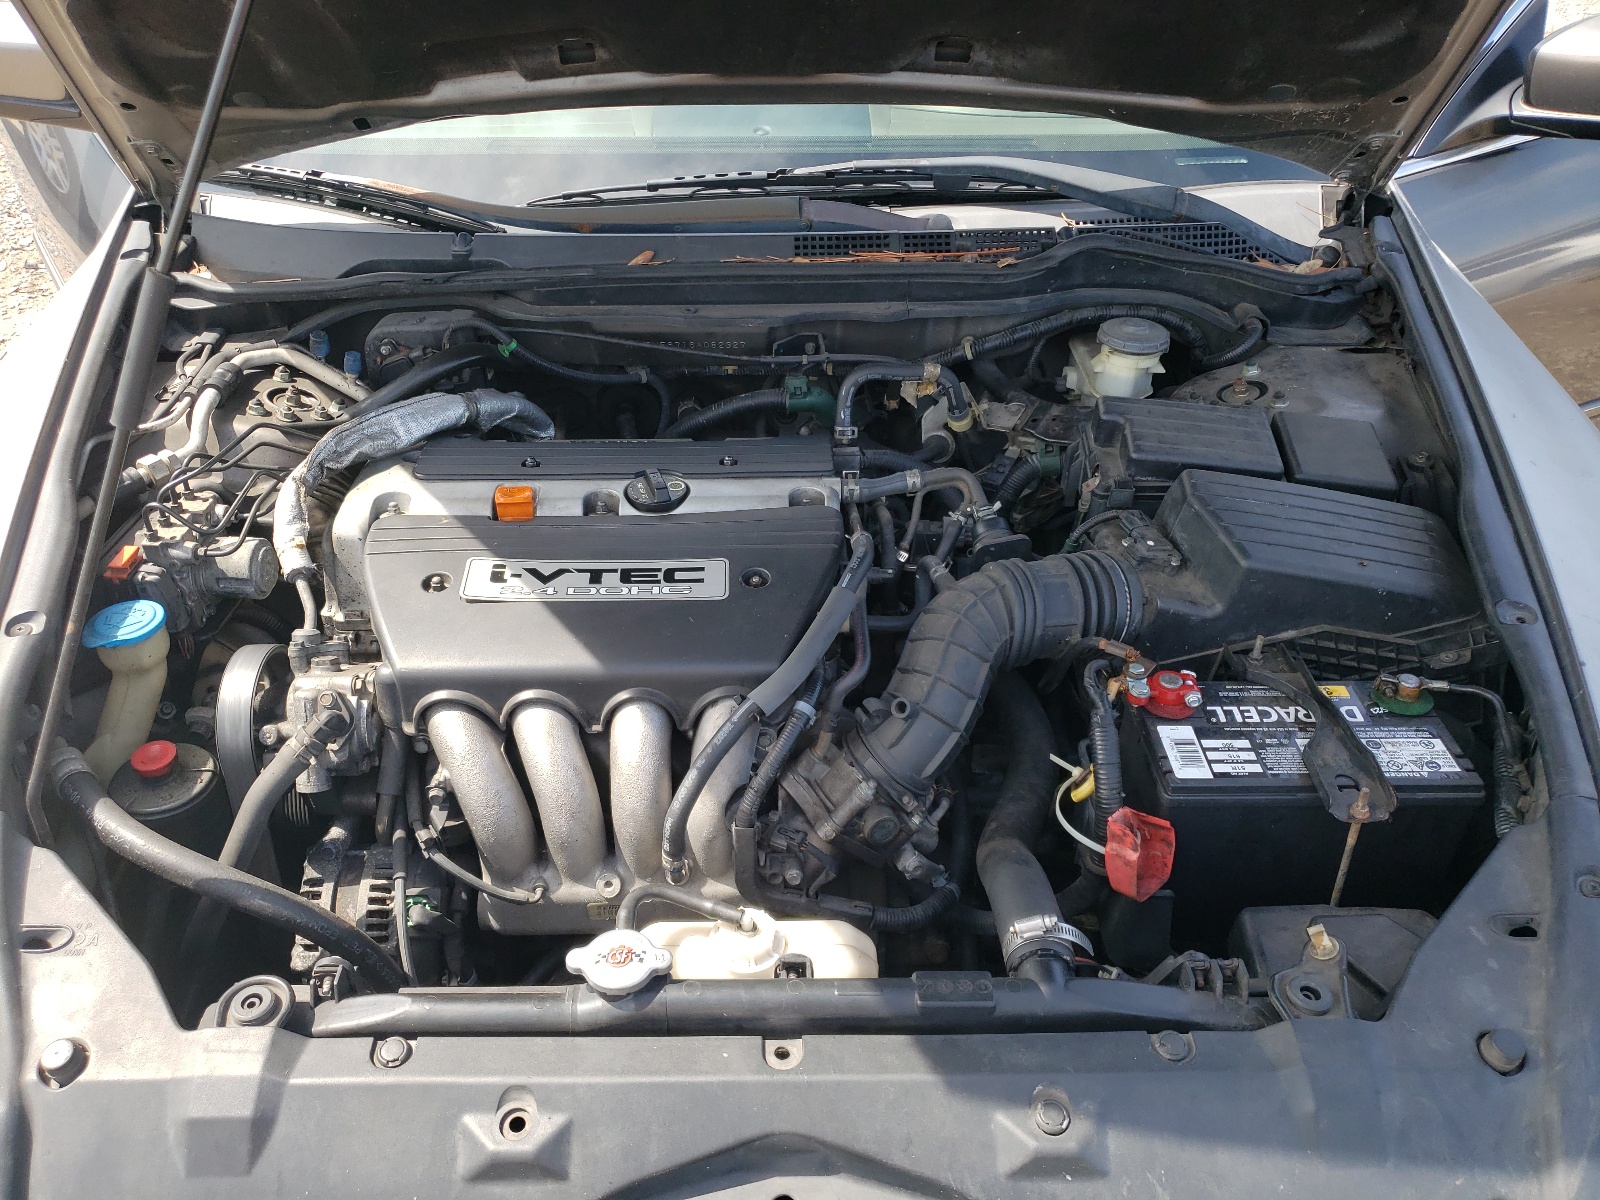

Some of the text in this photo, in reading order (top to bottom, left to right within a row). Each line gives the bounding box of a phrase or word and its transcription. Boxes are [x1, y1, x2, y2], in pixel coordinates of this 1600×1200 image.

[489, 563, 706, 585] i-VTEC
[499, 585, 693, 596] 2.4 DOHC
[1206, 706, 1365, 723] DRACELL
